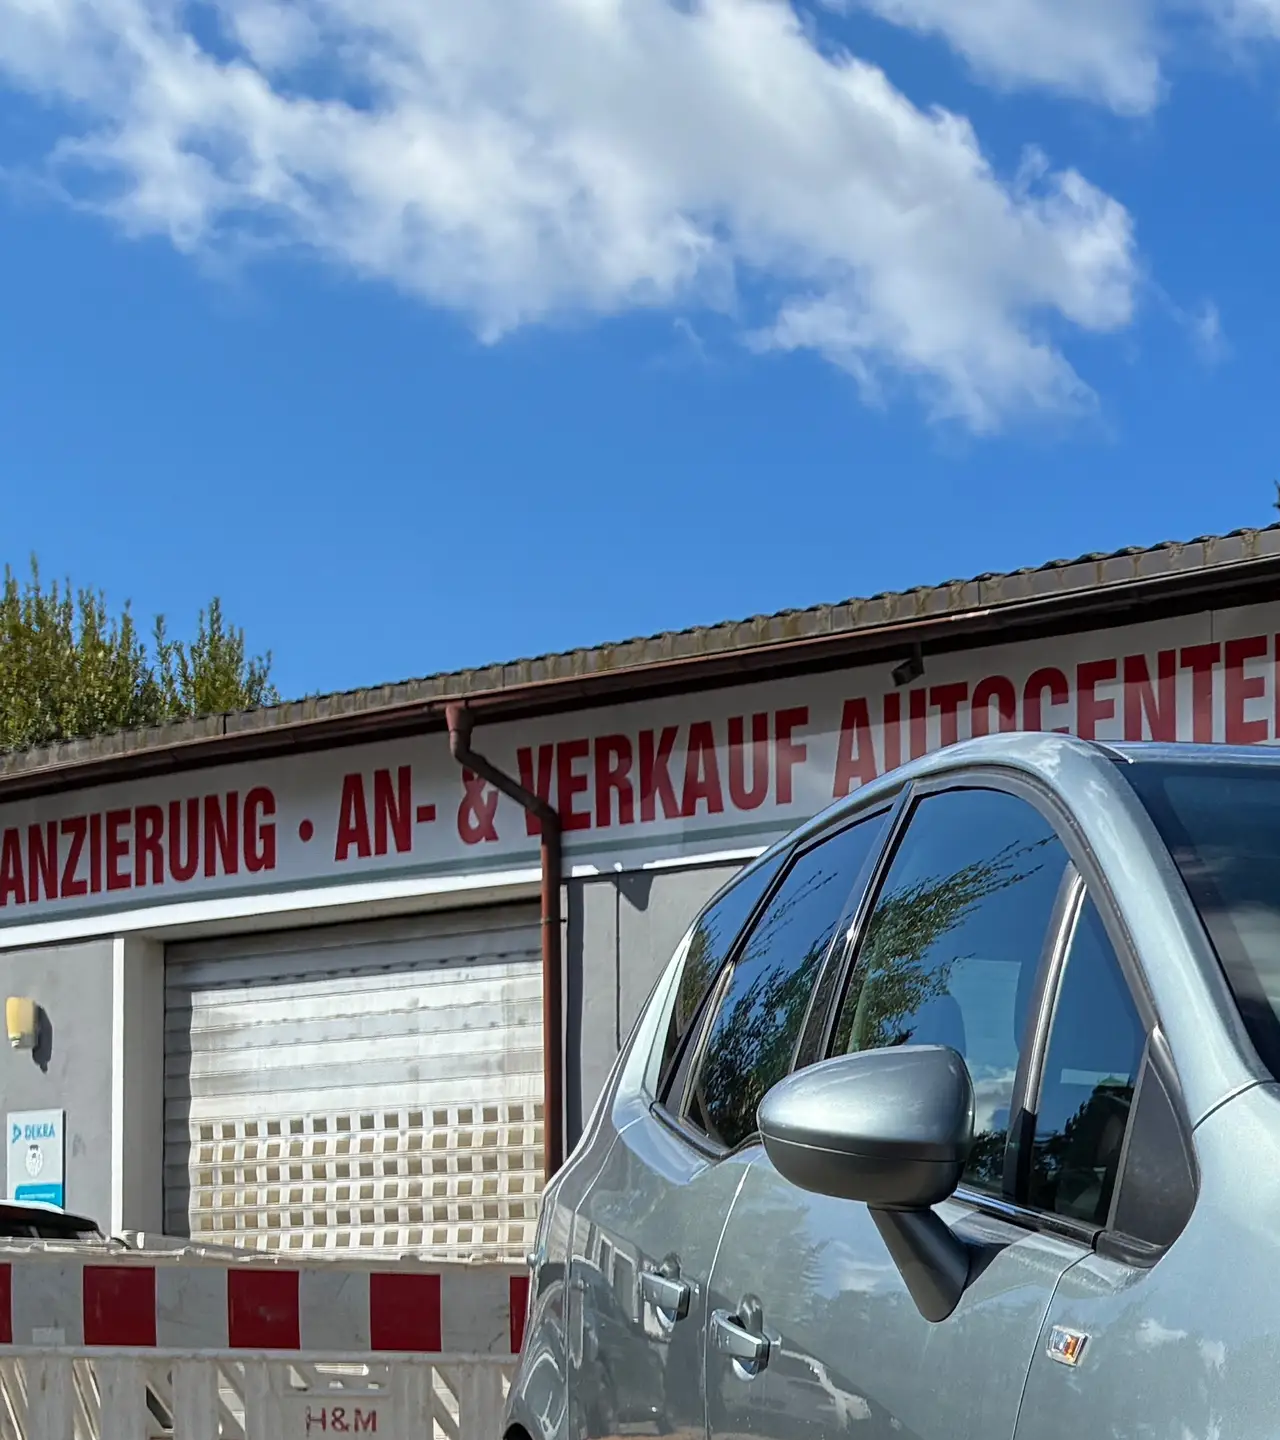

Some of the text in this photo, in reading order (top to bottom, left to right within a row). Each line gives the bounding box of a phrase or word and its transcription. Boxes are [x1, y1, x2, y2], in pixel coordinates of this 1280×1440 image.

[0, 786, 276, 908] ANZIERUNG
[335, 764, 436, 861] AN-
[457, 765, 499, 845] &
[516, 706, 809, 836] VERKAUF
[305, 1405, 377, 1436] H&M
